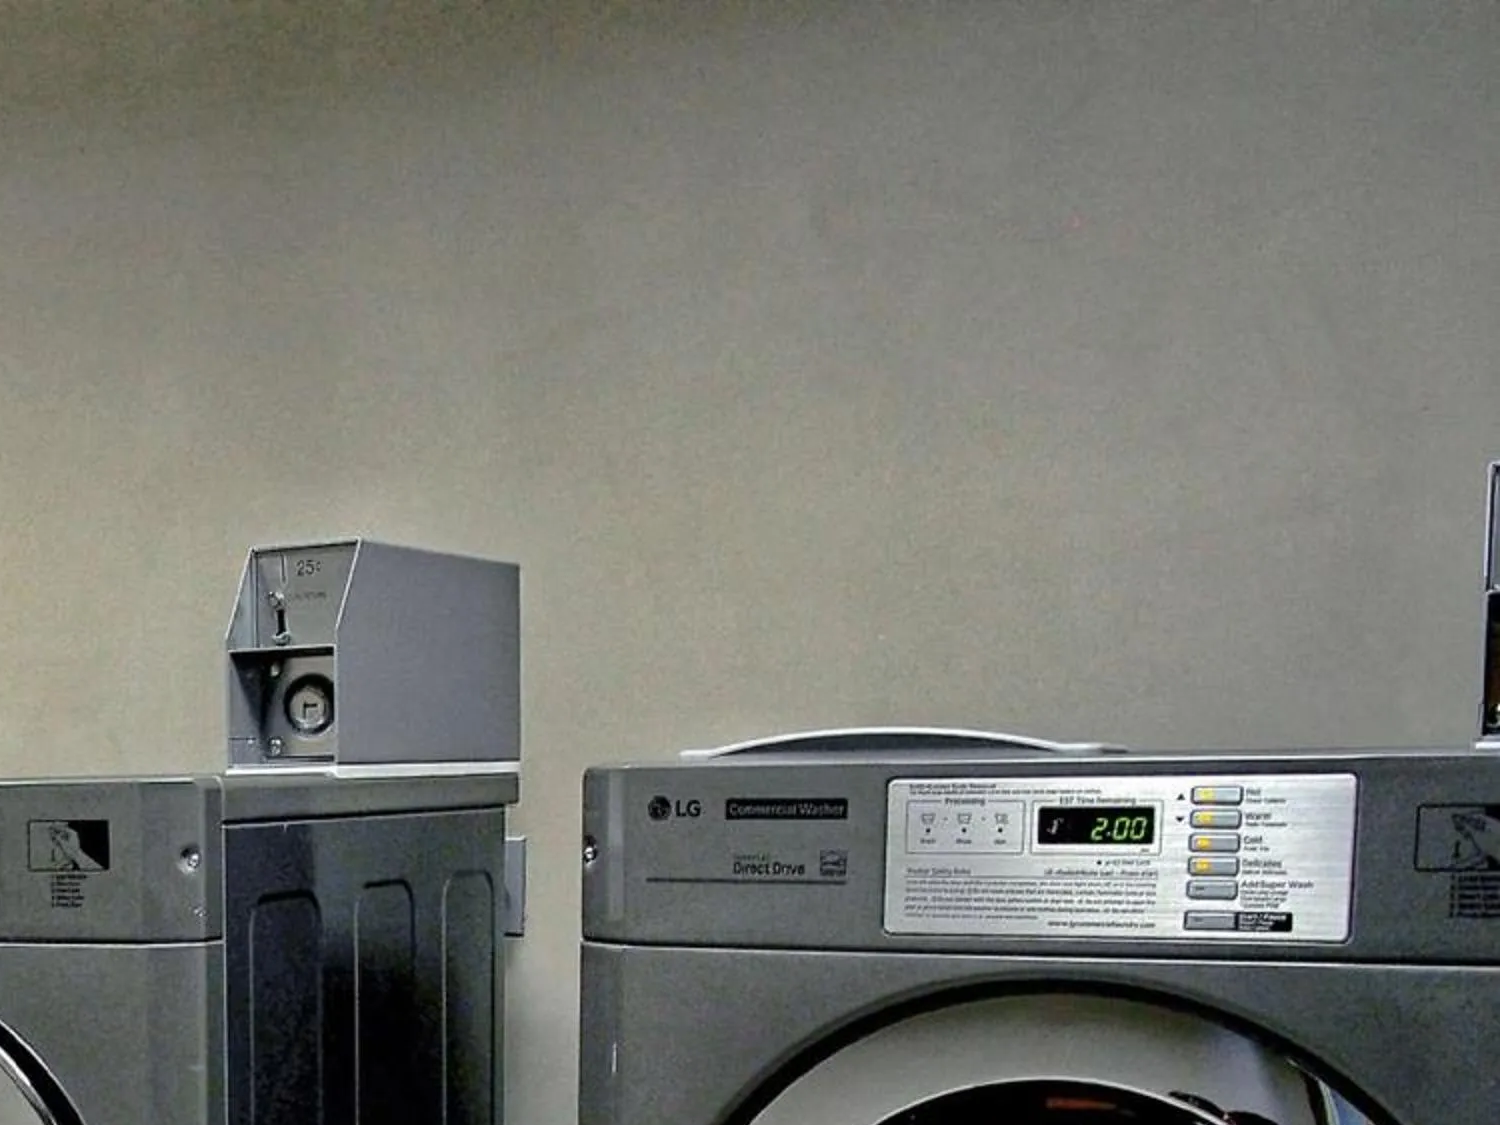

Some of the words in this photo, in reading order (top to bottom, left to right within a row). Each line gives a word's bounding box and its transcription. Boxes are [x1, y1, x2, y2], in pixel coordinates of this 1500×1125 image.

[675, 799, 701, 817] LG
[729, 802, 796, 817] Commercial
[798, 802, 845, 817] Washer
[733, 861, 769, 875] Direct
[772, 862, 805, 875] Drive
